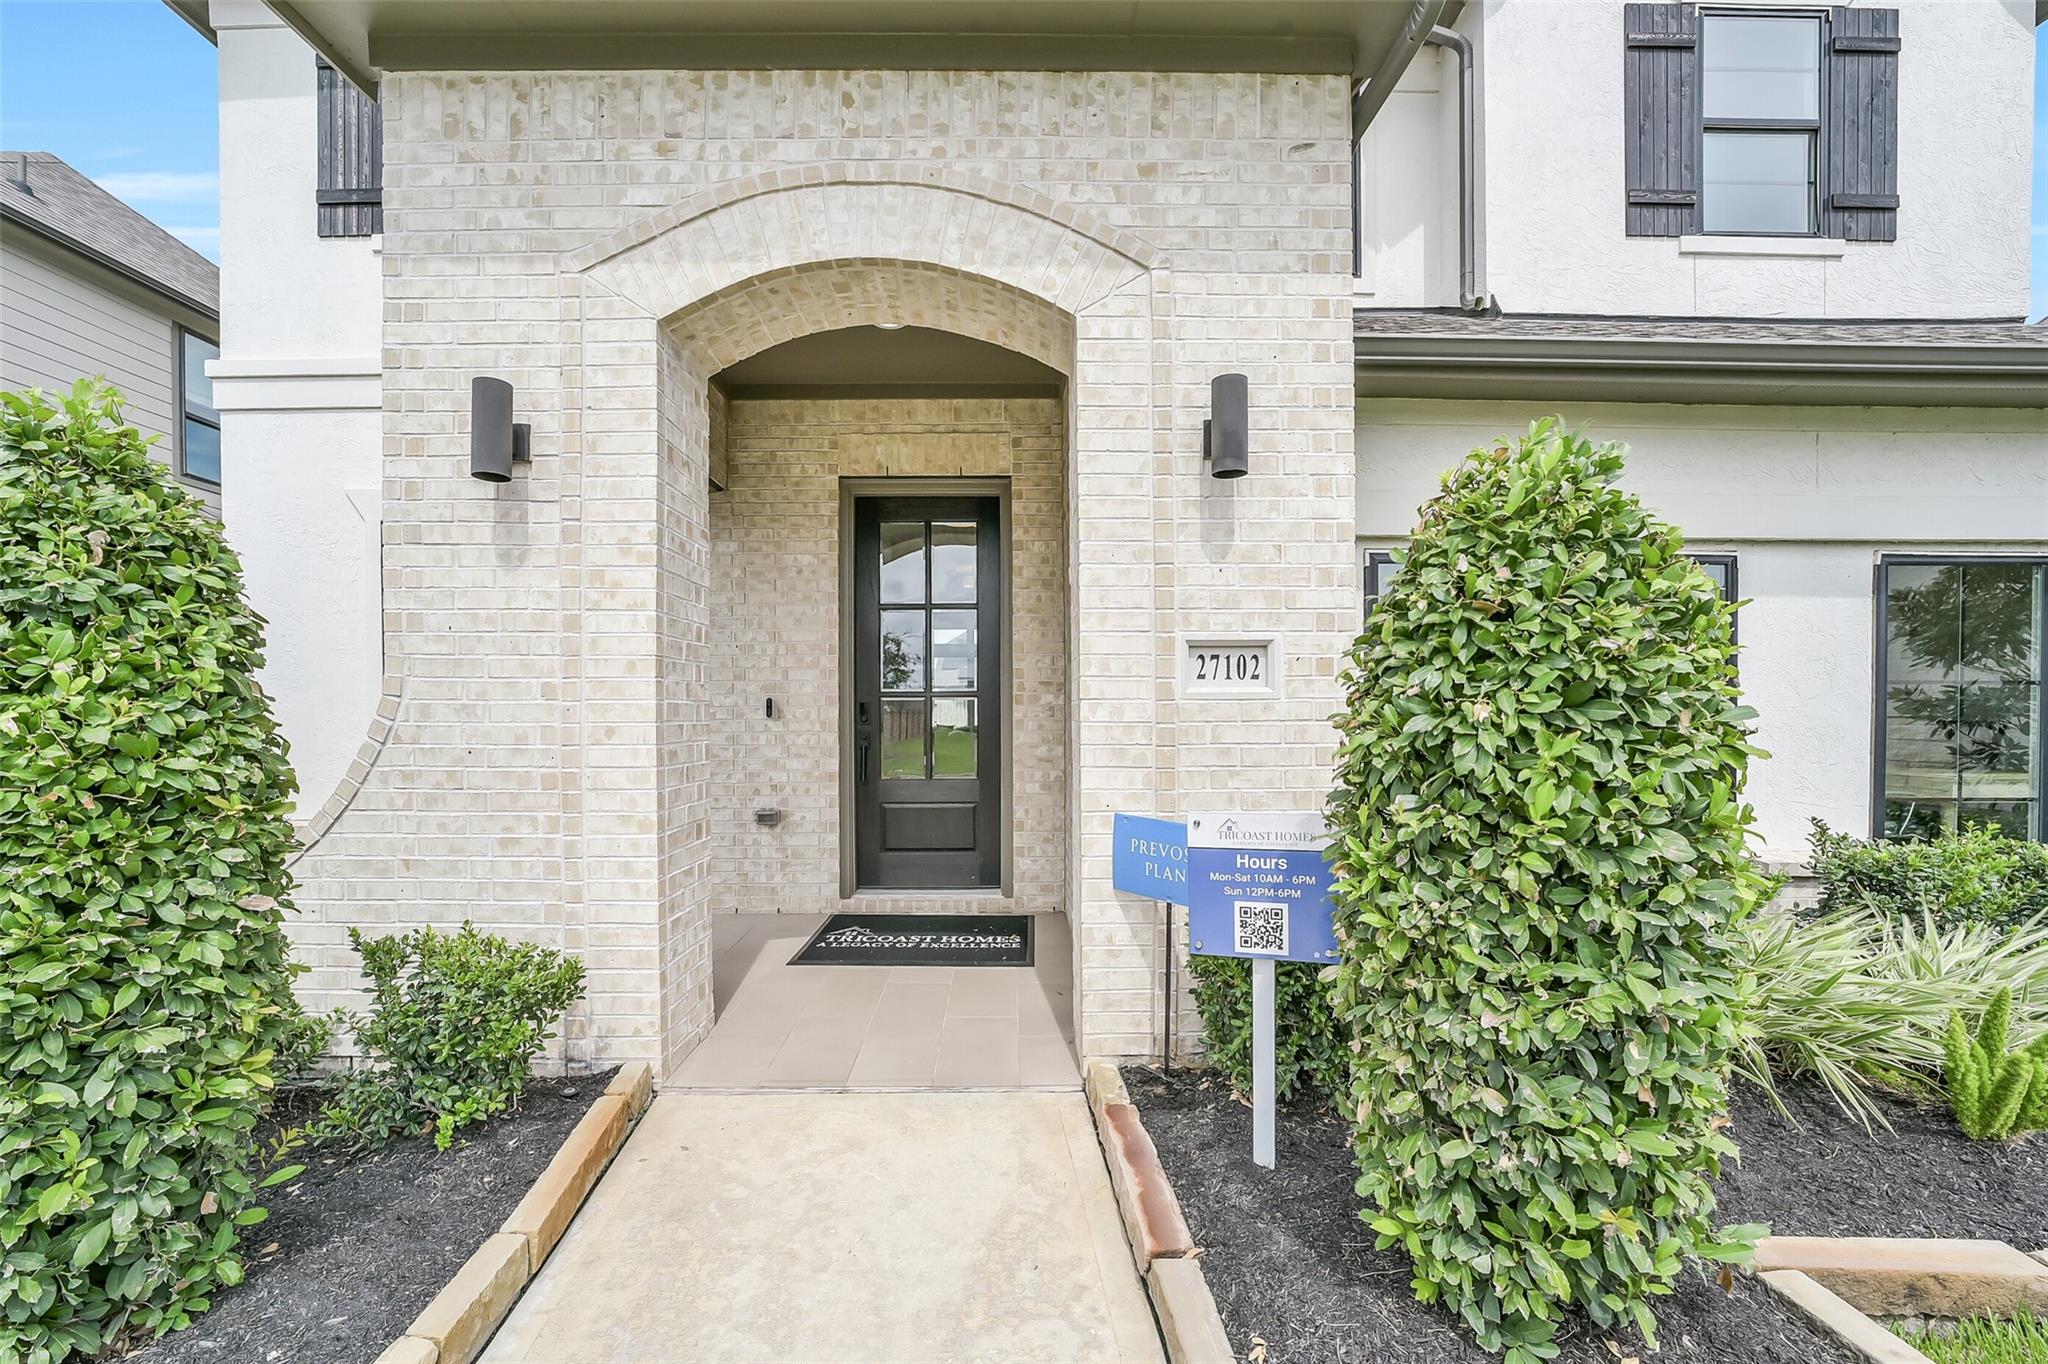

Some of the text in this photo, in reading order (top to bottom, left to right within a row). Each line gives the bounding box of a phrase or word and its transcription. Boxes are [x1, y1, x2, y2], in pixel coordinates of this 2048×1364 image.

[1195, 653, 1261, 681] 27102
[1217, 830, 1273, 841] TRICOAST
[1236, 853, 1288, 870] Hours
[1145, 861, 1187, 884] PLAN
[1209, 872, 1252, 883] Mon-Sat
[1254, 873, 1284, 884] 10AM
[1292, 875, 1317, 886] 6PM
[1223, 886, 1302, 899] Sun 12PM-6PM
[825, 934, 1021, 943] TRICOAST HOMES
